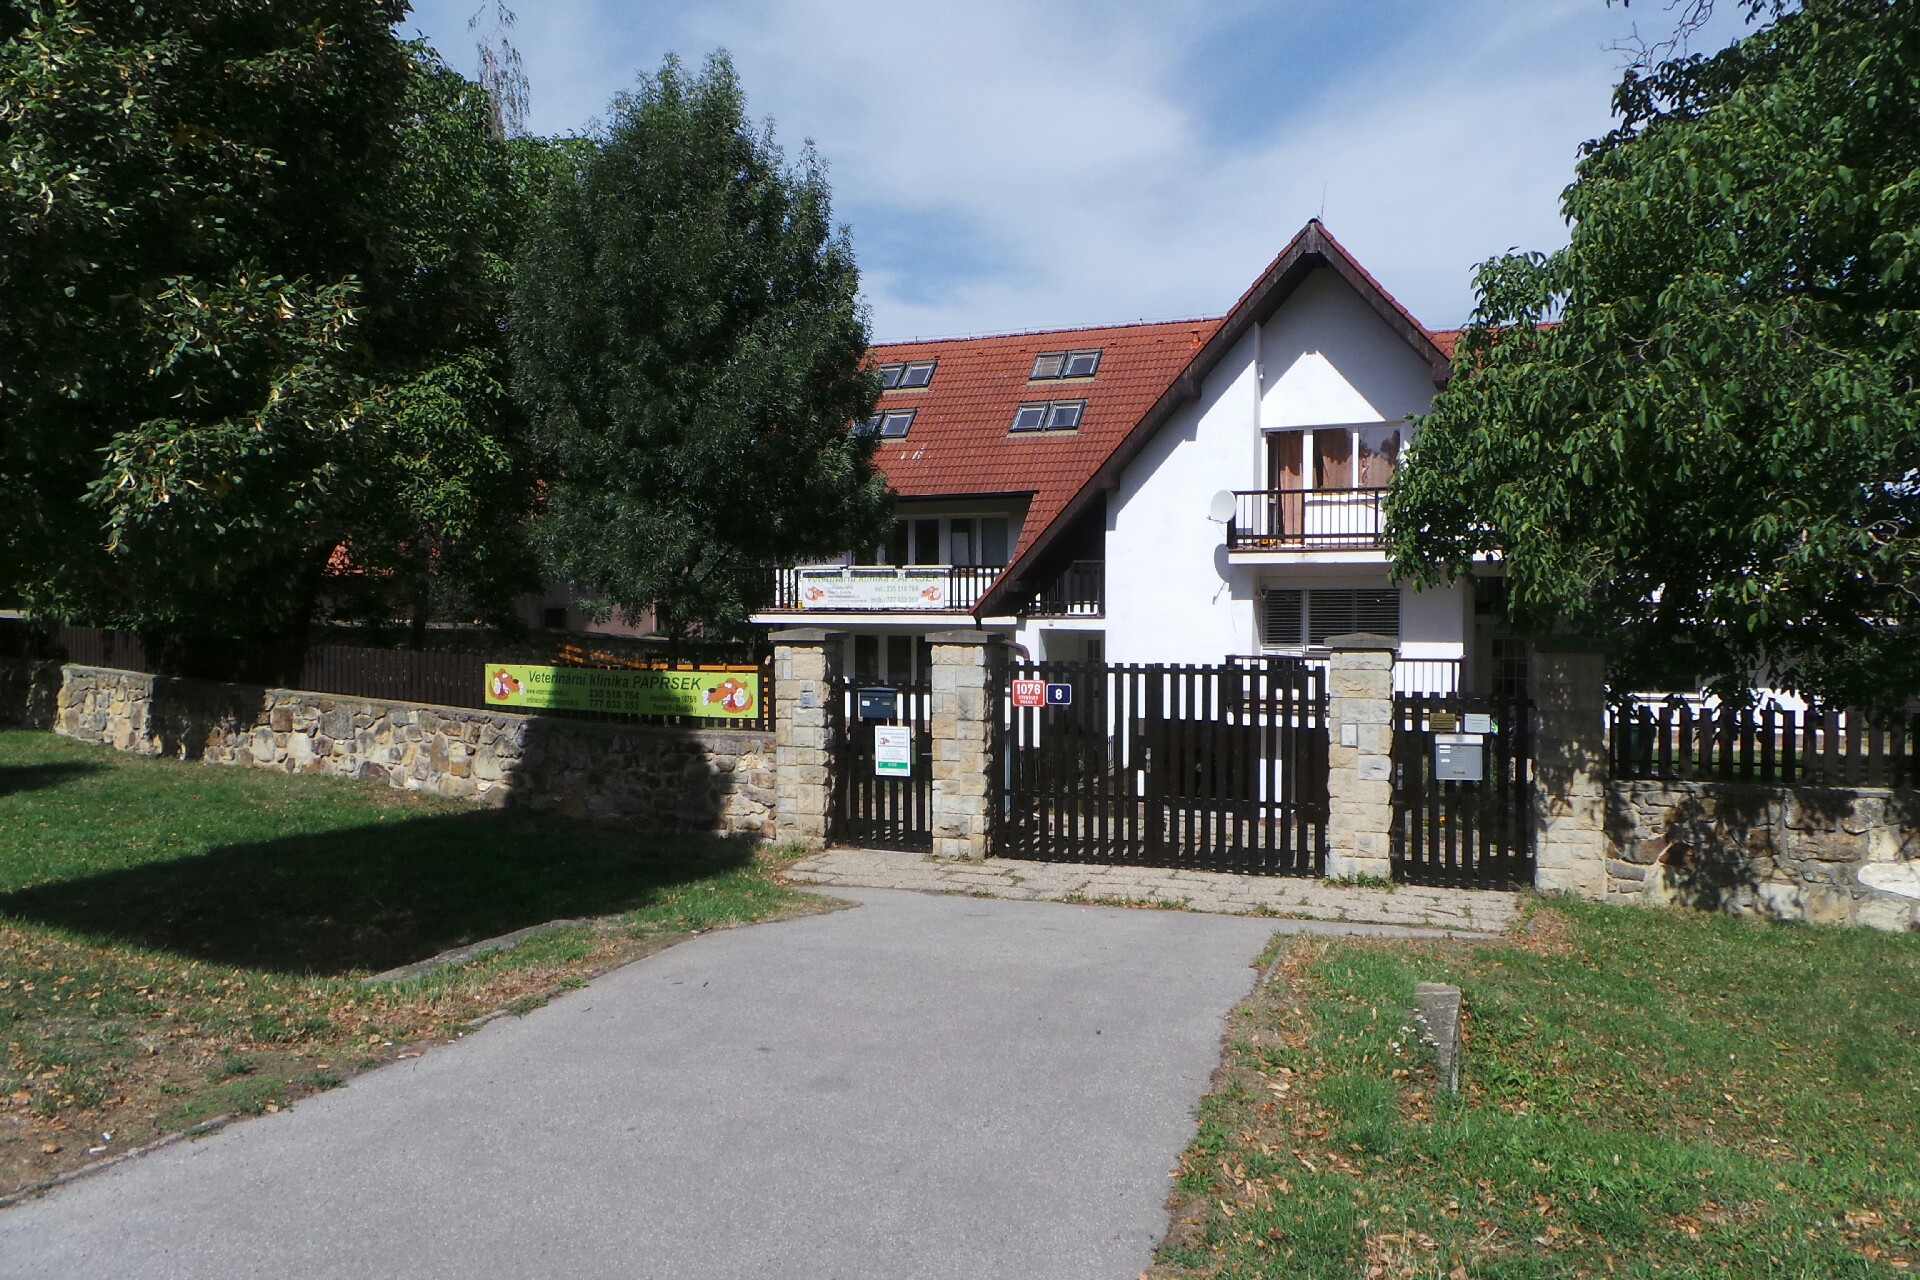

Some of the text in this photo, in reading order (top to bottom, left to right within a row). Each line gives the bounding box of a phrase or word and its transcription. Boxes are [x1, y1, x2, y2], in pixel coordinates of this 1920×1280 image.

[528, 671, 702, 690] Veterinární klinika PAPRSEK
[588, 689, 639, 699] 235 518 764
[1016, 684, 1041, 695] 1076
[1055, 688, 1063, 700] 8
[589, 699, 604, 707] 777
[606, 700, 621, 708] 033
